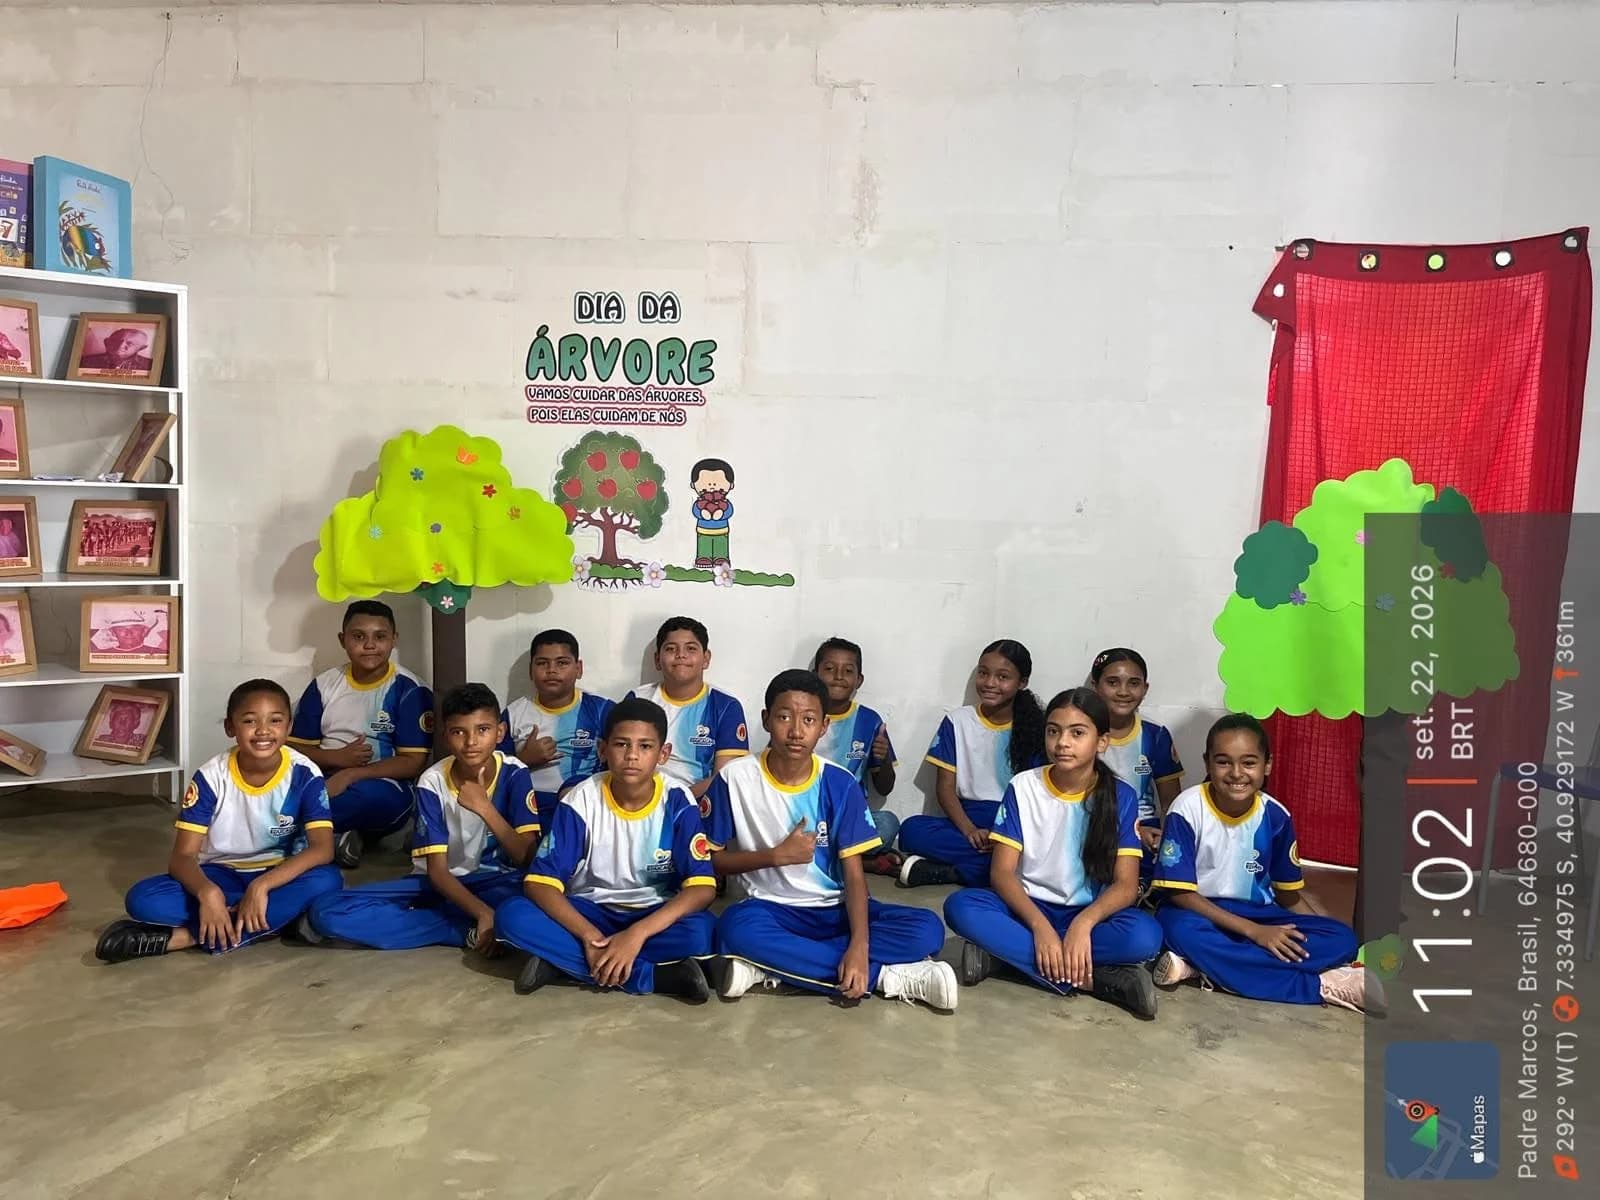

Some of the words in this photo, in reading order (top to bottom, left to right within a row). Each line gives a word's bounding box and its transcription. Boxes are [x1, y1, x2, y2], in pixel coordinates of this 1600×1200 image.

[576, 293, 623, 321] DIA
[640, 293, 679, 321] DA
[526, 324, 717, 386] ÁRVORE
[528, 387, 570, 400] VAMOS
[573, 388, 616, 401] CUIDAR
[618, 390, 642, 401] DAS
[531, 408, 558, 421] POIS
[561, 409, 590, 421] ELAS
[593, 410, 638, 422] CUIDAM
[641, 411, 657, 422] DE
[659, 406, 684, 422] NÓS
